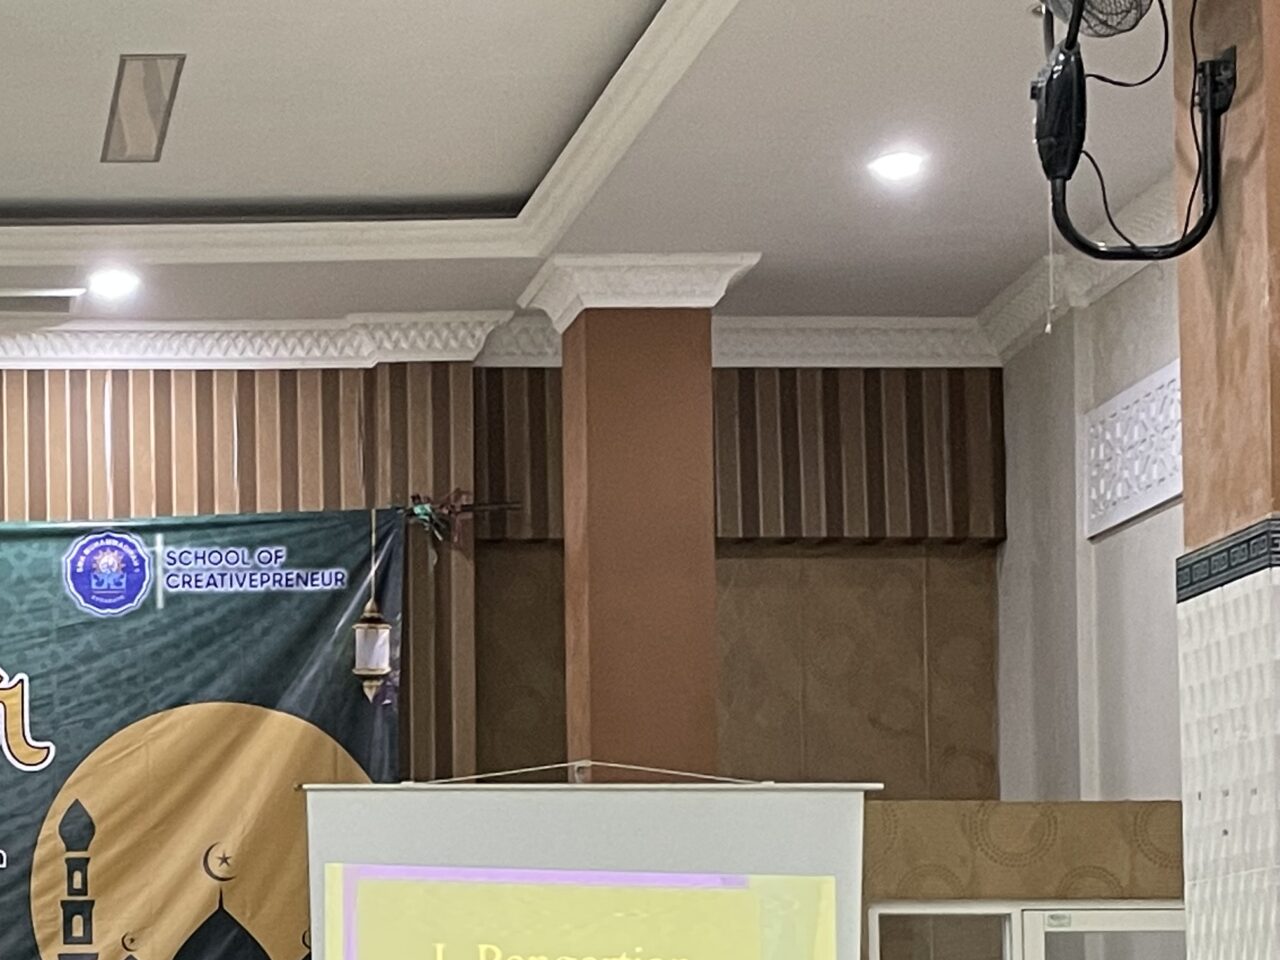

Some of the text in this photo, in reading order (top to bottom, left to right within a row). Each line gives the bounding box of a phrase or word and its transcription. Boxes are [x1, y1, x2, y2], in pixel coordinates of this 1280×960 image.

[165, 549, 285, 566] SCHOOL OF
[165, 571, 346, 589] CREATIVEPRENEUR
